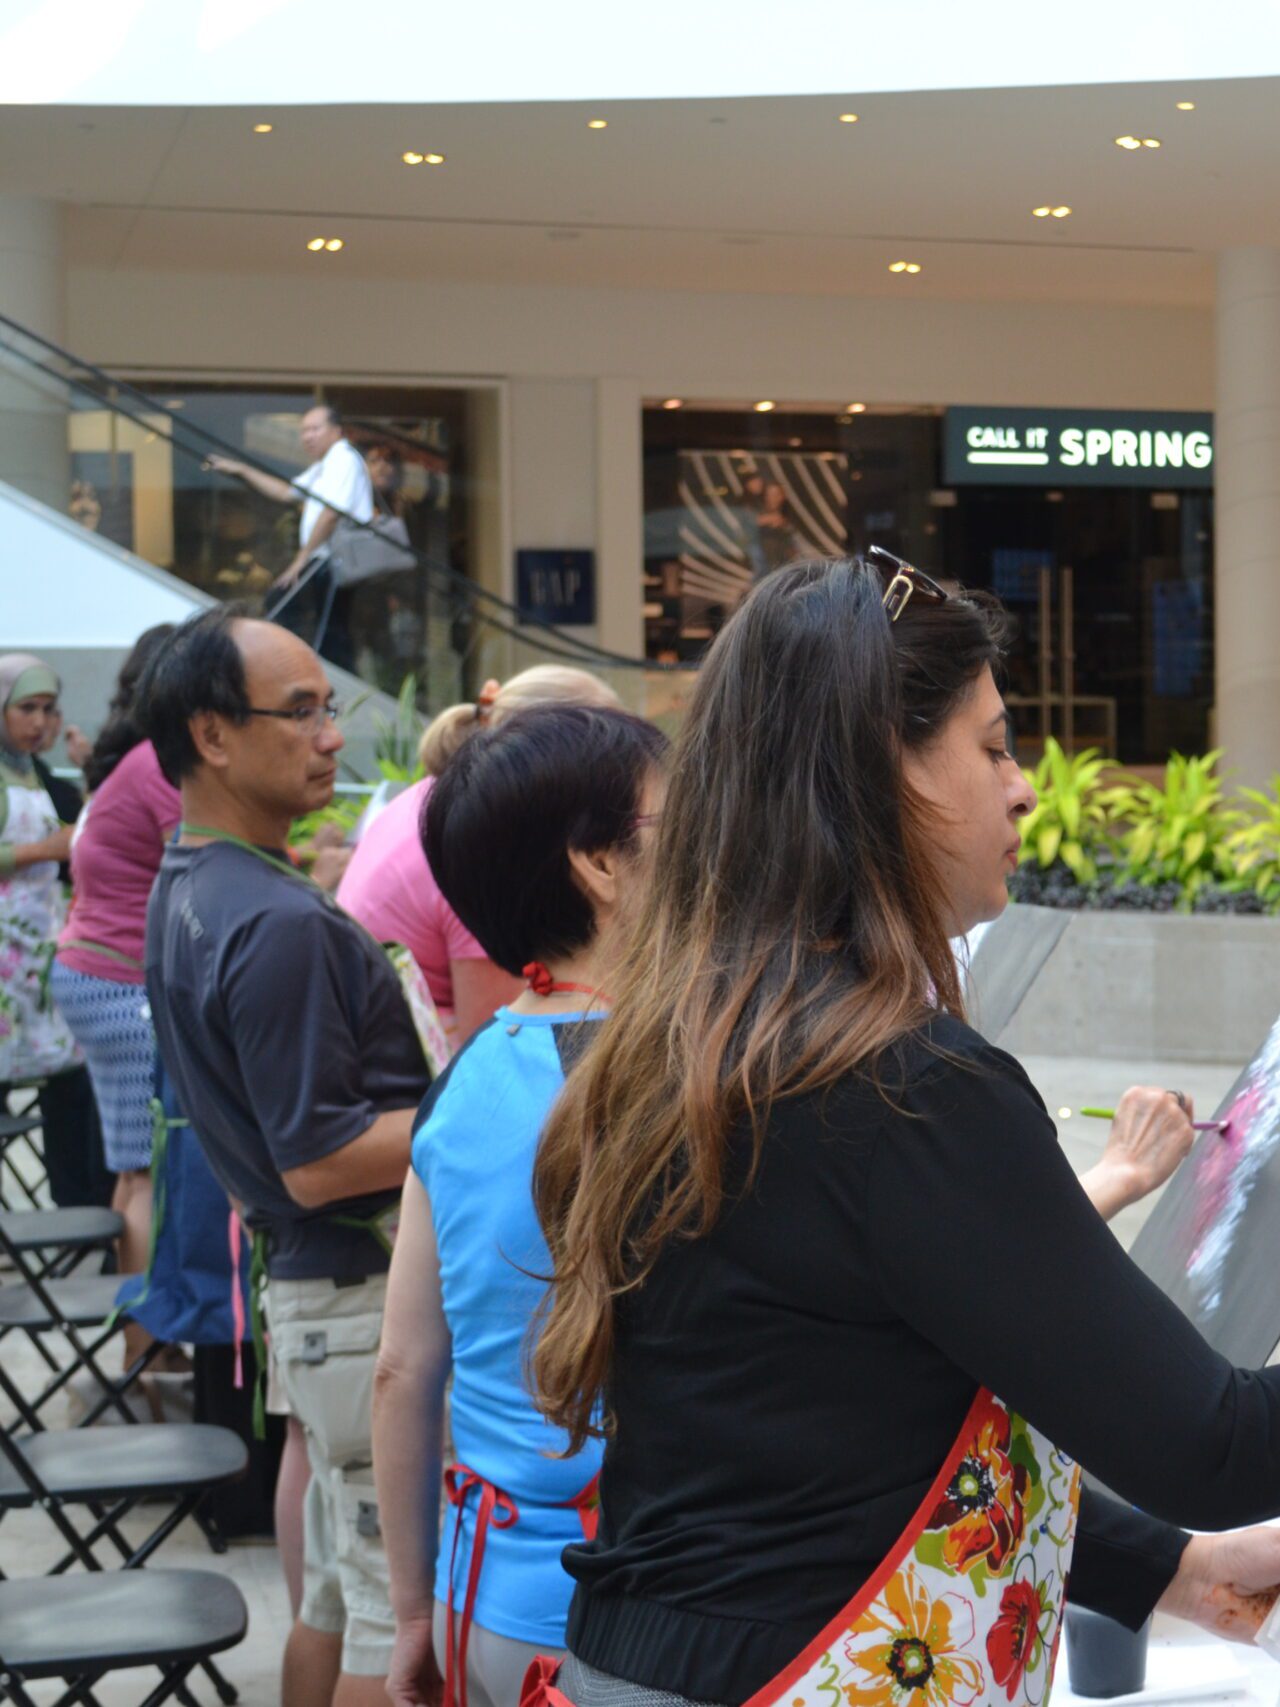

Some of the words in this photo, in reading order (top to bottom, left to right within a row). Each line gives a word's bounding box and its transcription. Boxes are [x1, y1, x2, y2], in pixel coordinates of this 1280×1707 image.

[967, 426, 1019, 449] CALL
[1026, 428, 1048, 449] IT
[1059, 428, 1213, 469] SPRING
